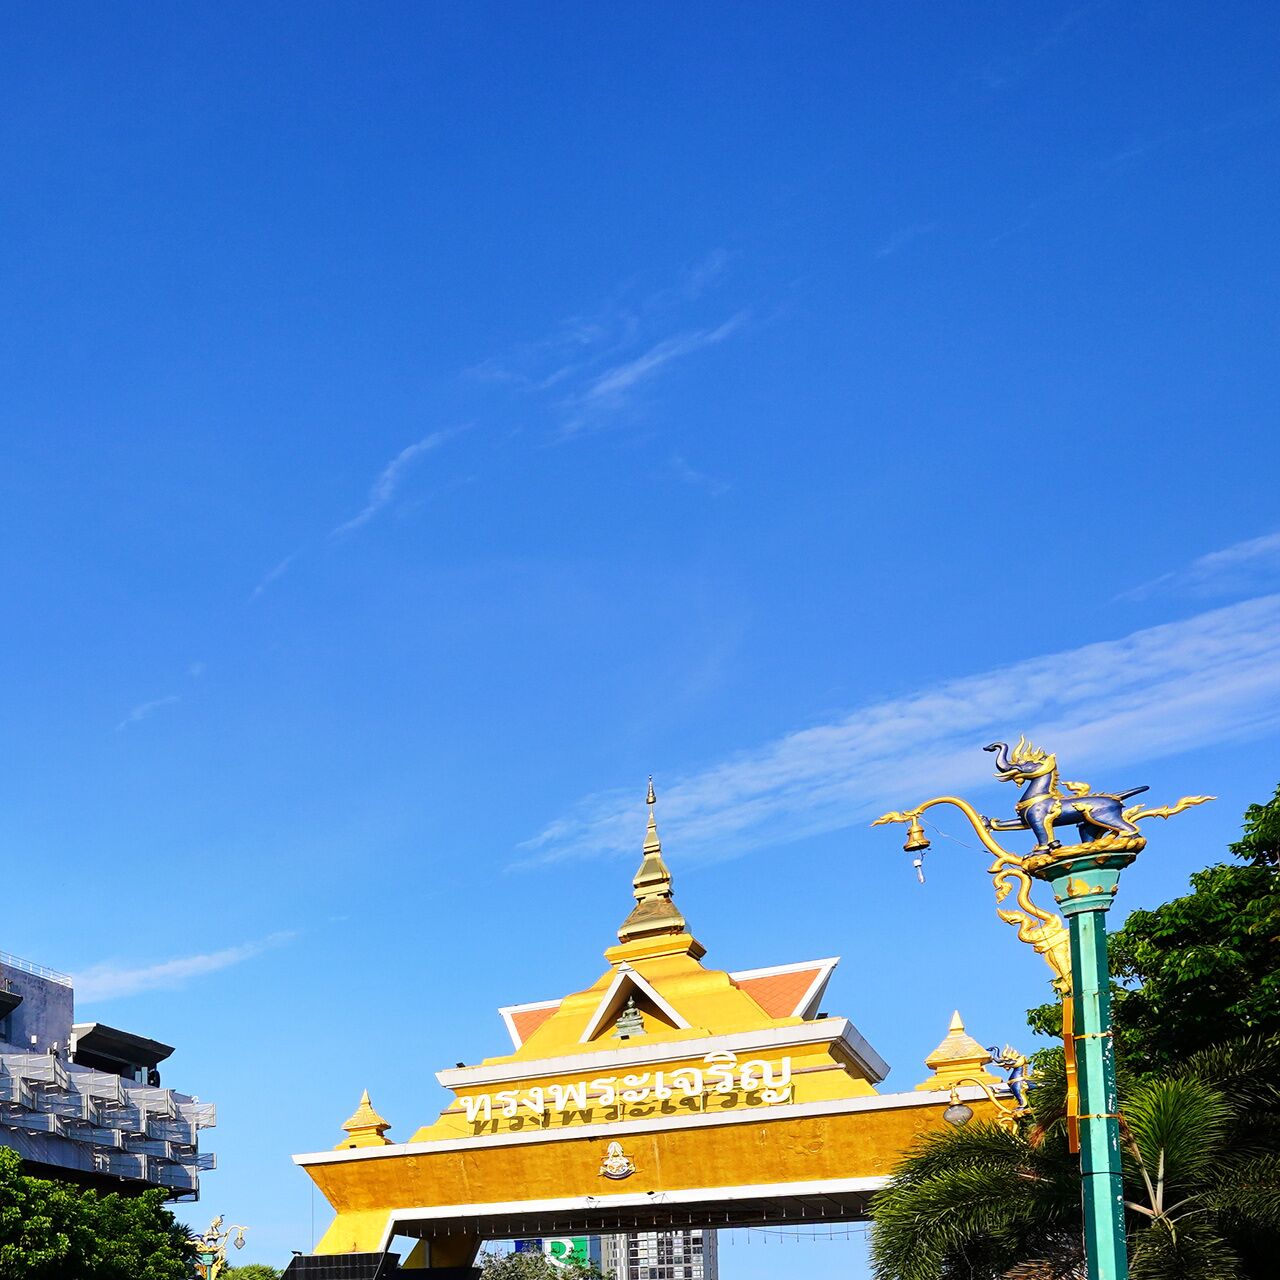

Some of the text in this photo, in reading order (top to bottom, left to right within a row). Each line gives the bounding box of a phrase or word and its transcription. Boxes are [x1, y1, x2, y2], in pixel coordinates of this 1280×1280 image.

[459, 1050, 792, 1123] ทรงพระเจริญ
